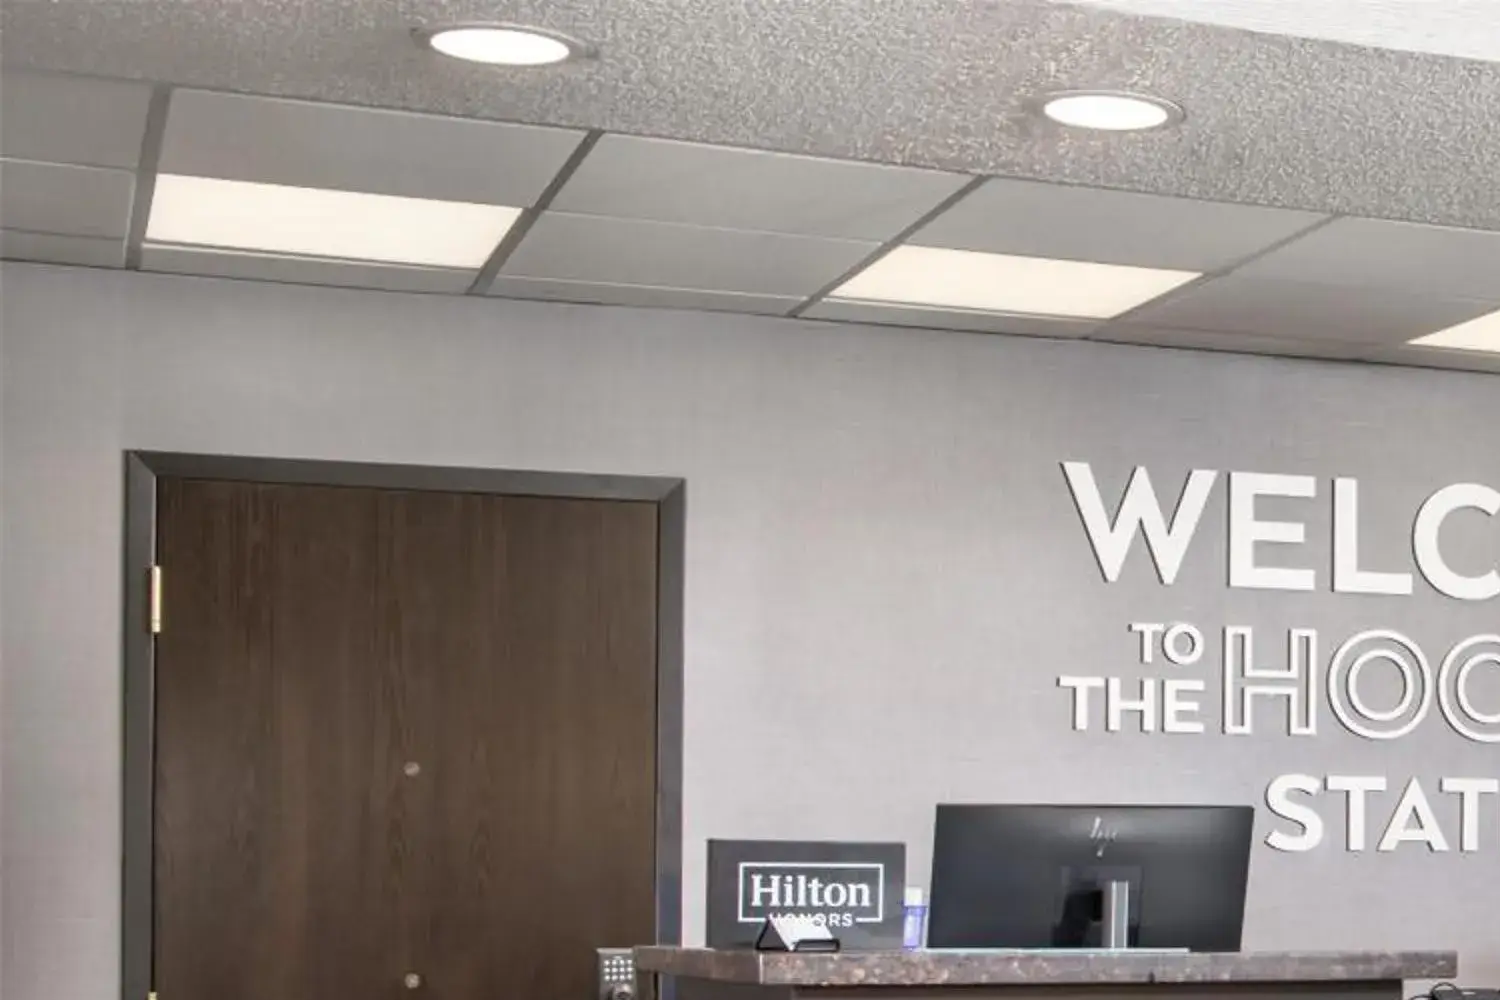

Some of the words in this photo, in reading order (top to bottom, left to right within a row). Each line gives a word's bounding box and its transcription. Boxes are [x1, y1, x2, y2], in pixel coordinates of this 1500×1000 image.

[1131, 622, 1204, 666] TO
[1058, 675, 1206, 734] THE
[751, 874, 871, 907] Hilton
